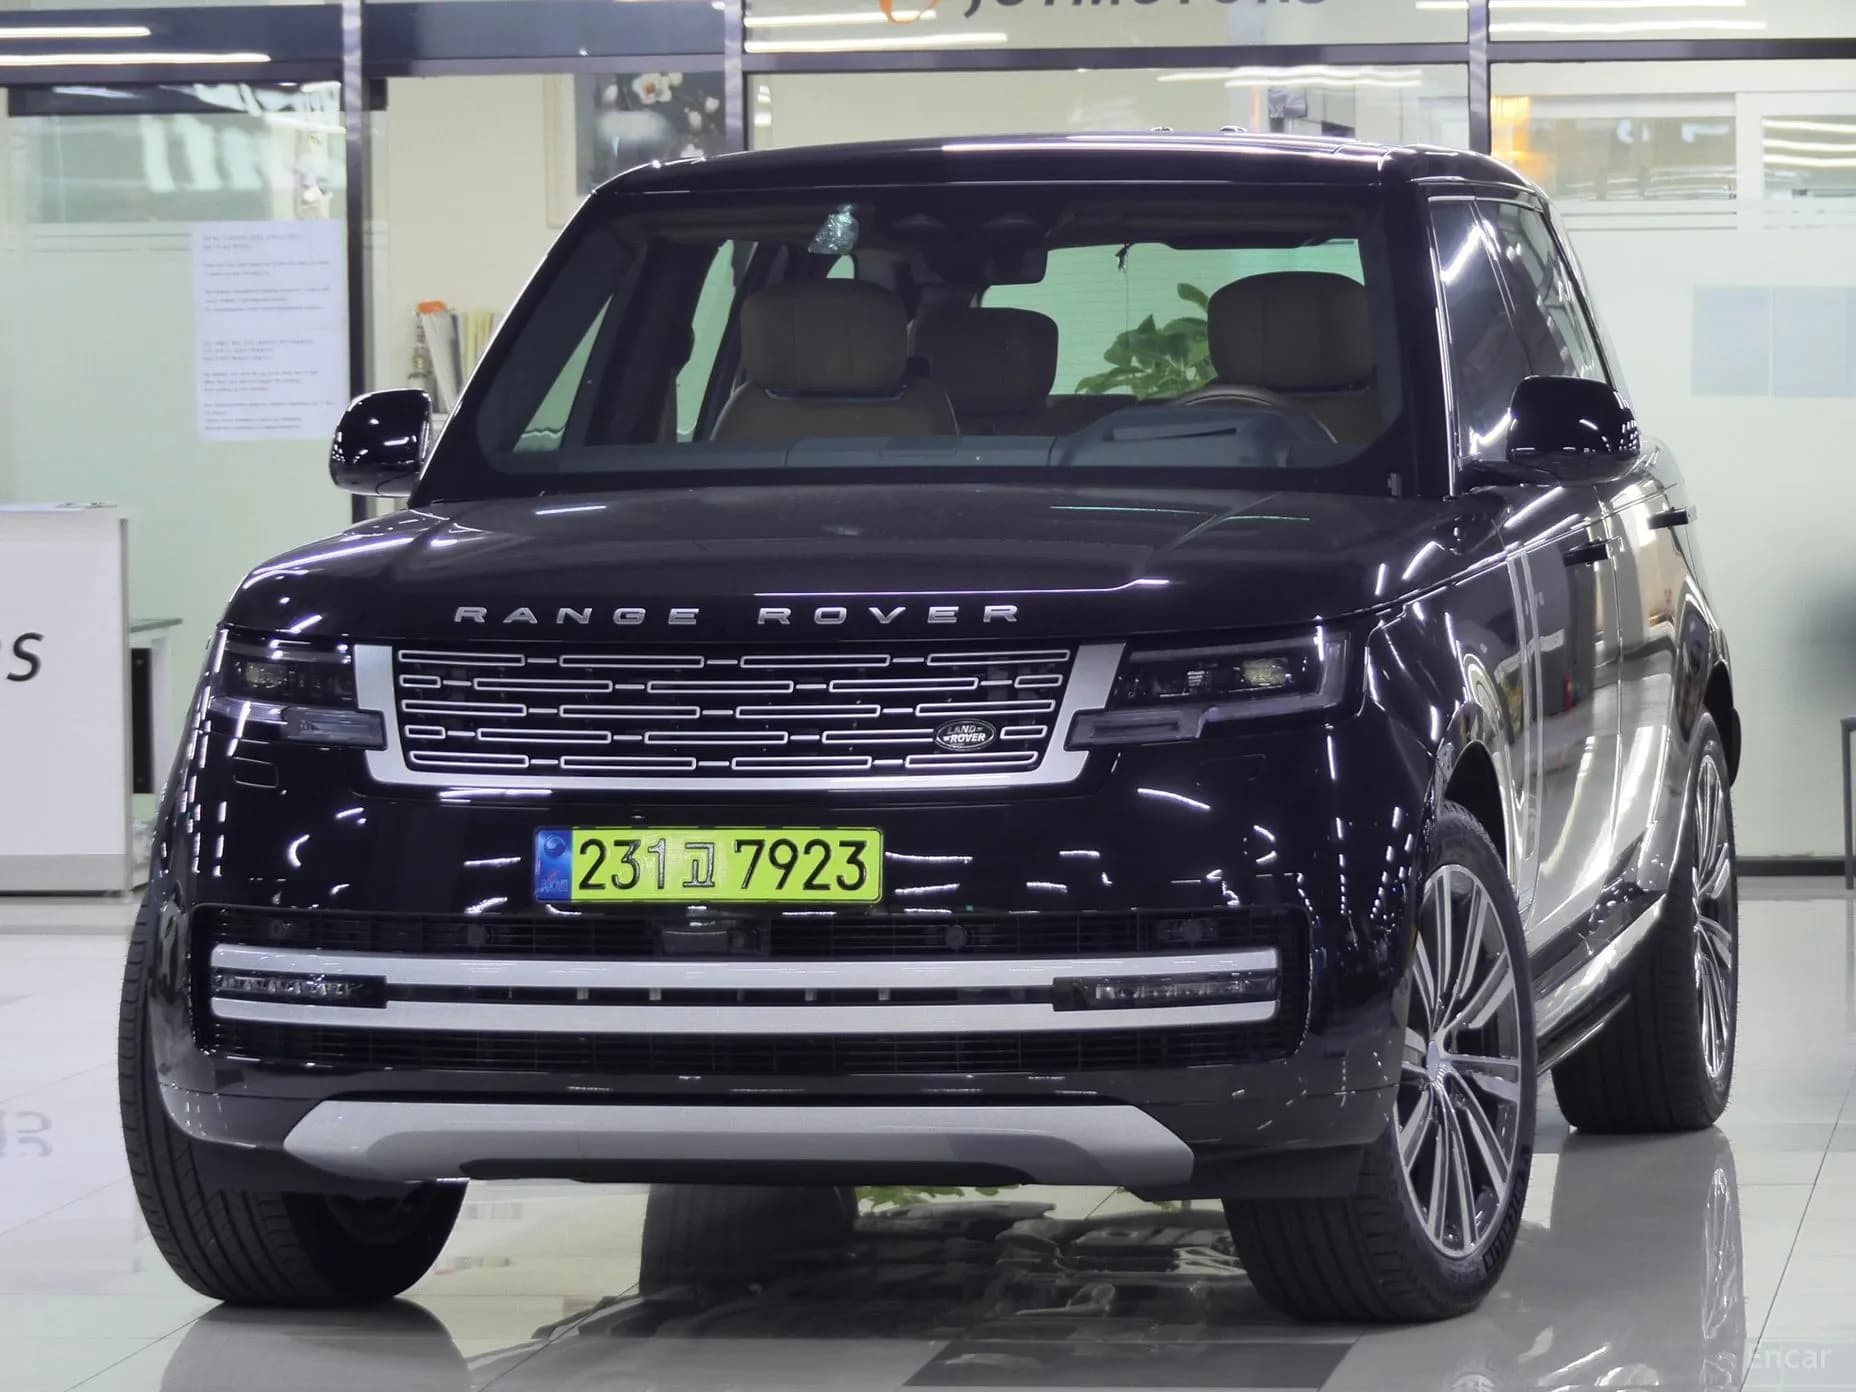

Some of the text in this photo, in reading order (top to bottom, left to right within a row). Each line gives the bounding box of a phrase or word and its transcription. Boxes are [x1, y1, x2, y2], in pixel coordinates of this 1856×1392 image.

[454, 605, 1018, 625] RANGE ROVER
[950, 733, 985, 743] ROVER
[735, 838, 868, 890] 7923
